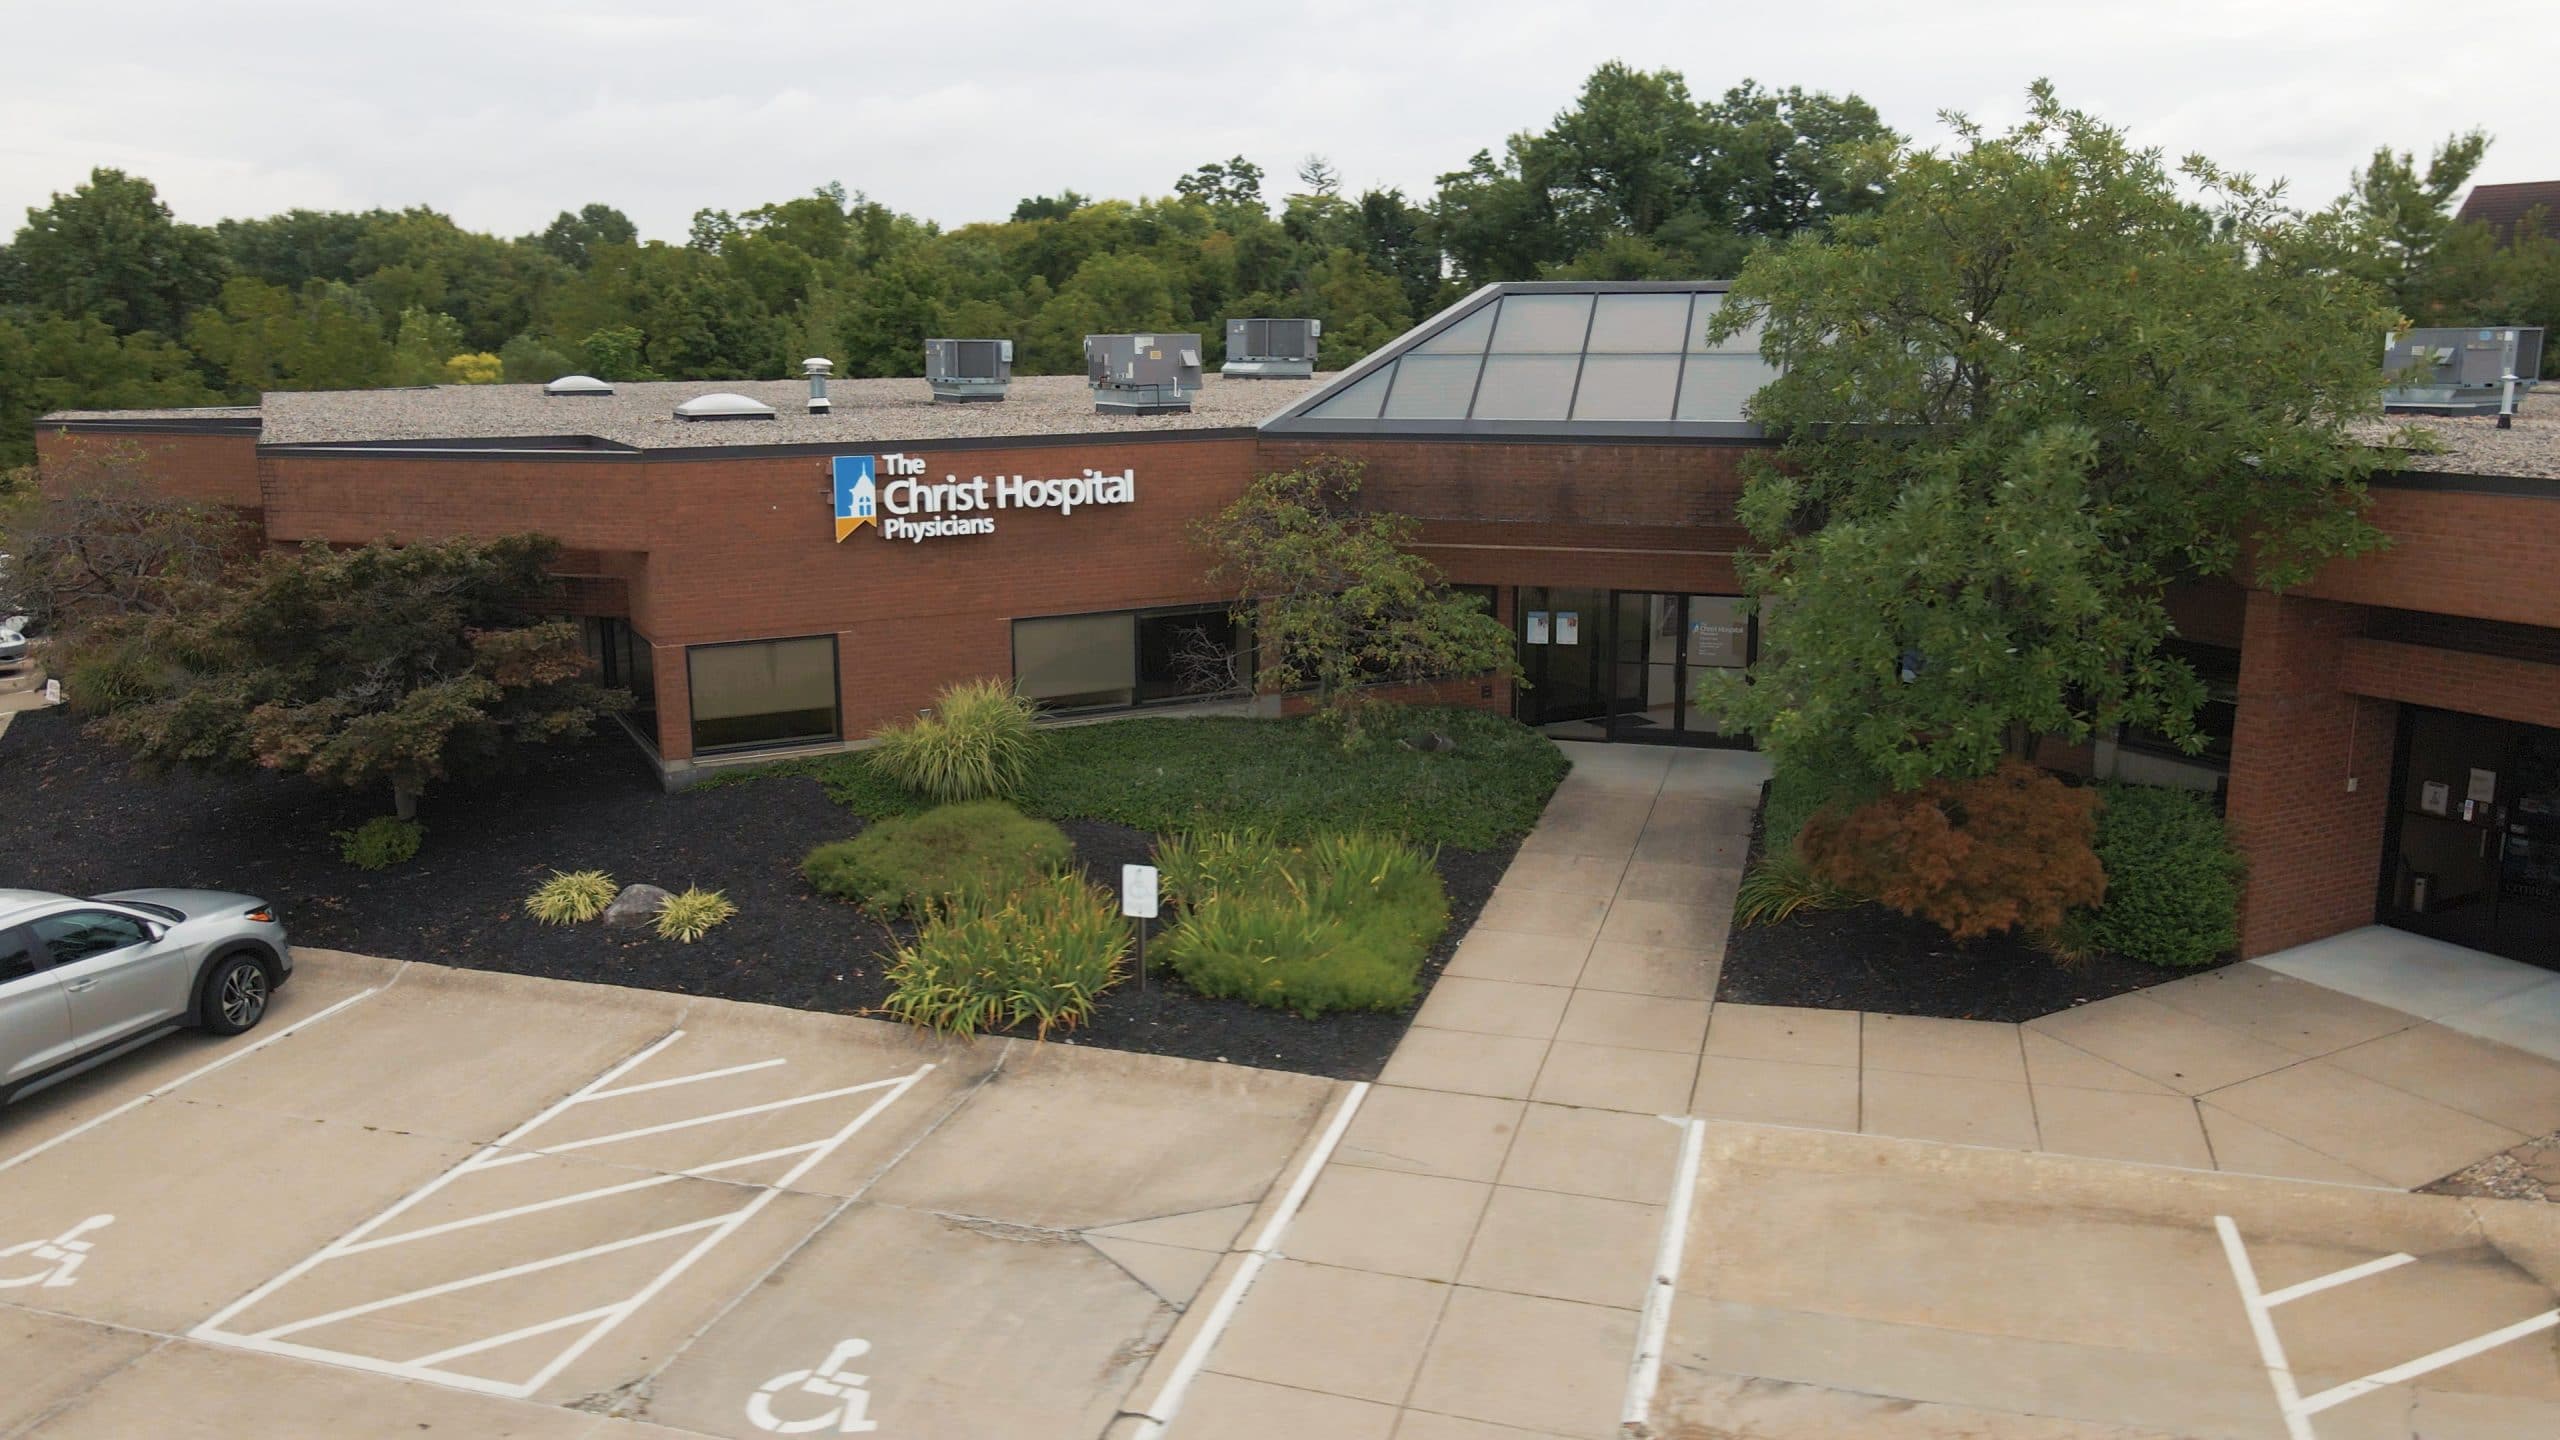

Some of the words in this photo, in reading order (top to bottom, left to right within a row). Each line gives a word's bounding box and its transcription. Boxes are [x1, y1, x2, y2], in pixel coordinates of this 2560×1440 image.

[882, 453, 926, 476] The
[883, 474, 989, 514] Christ
[995, 469, 1135, 516] Hospital
[884, 515, 995, 543] Physicians
